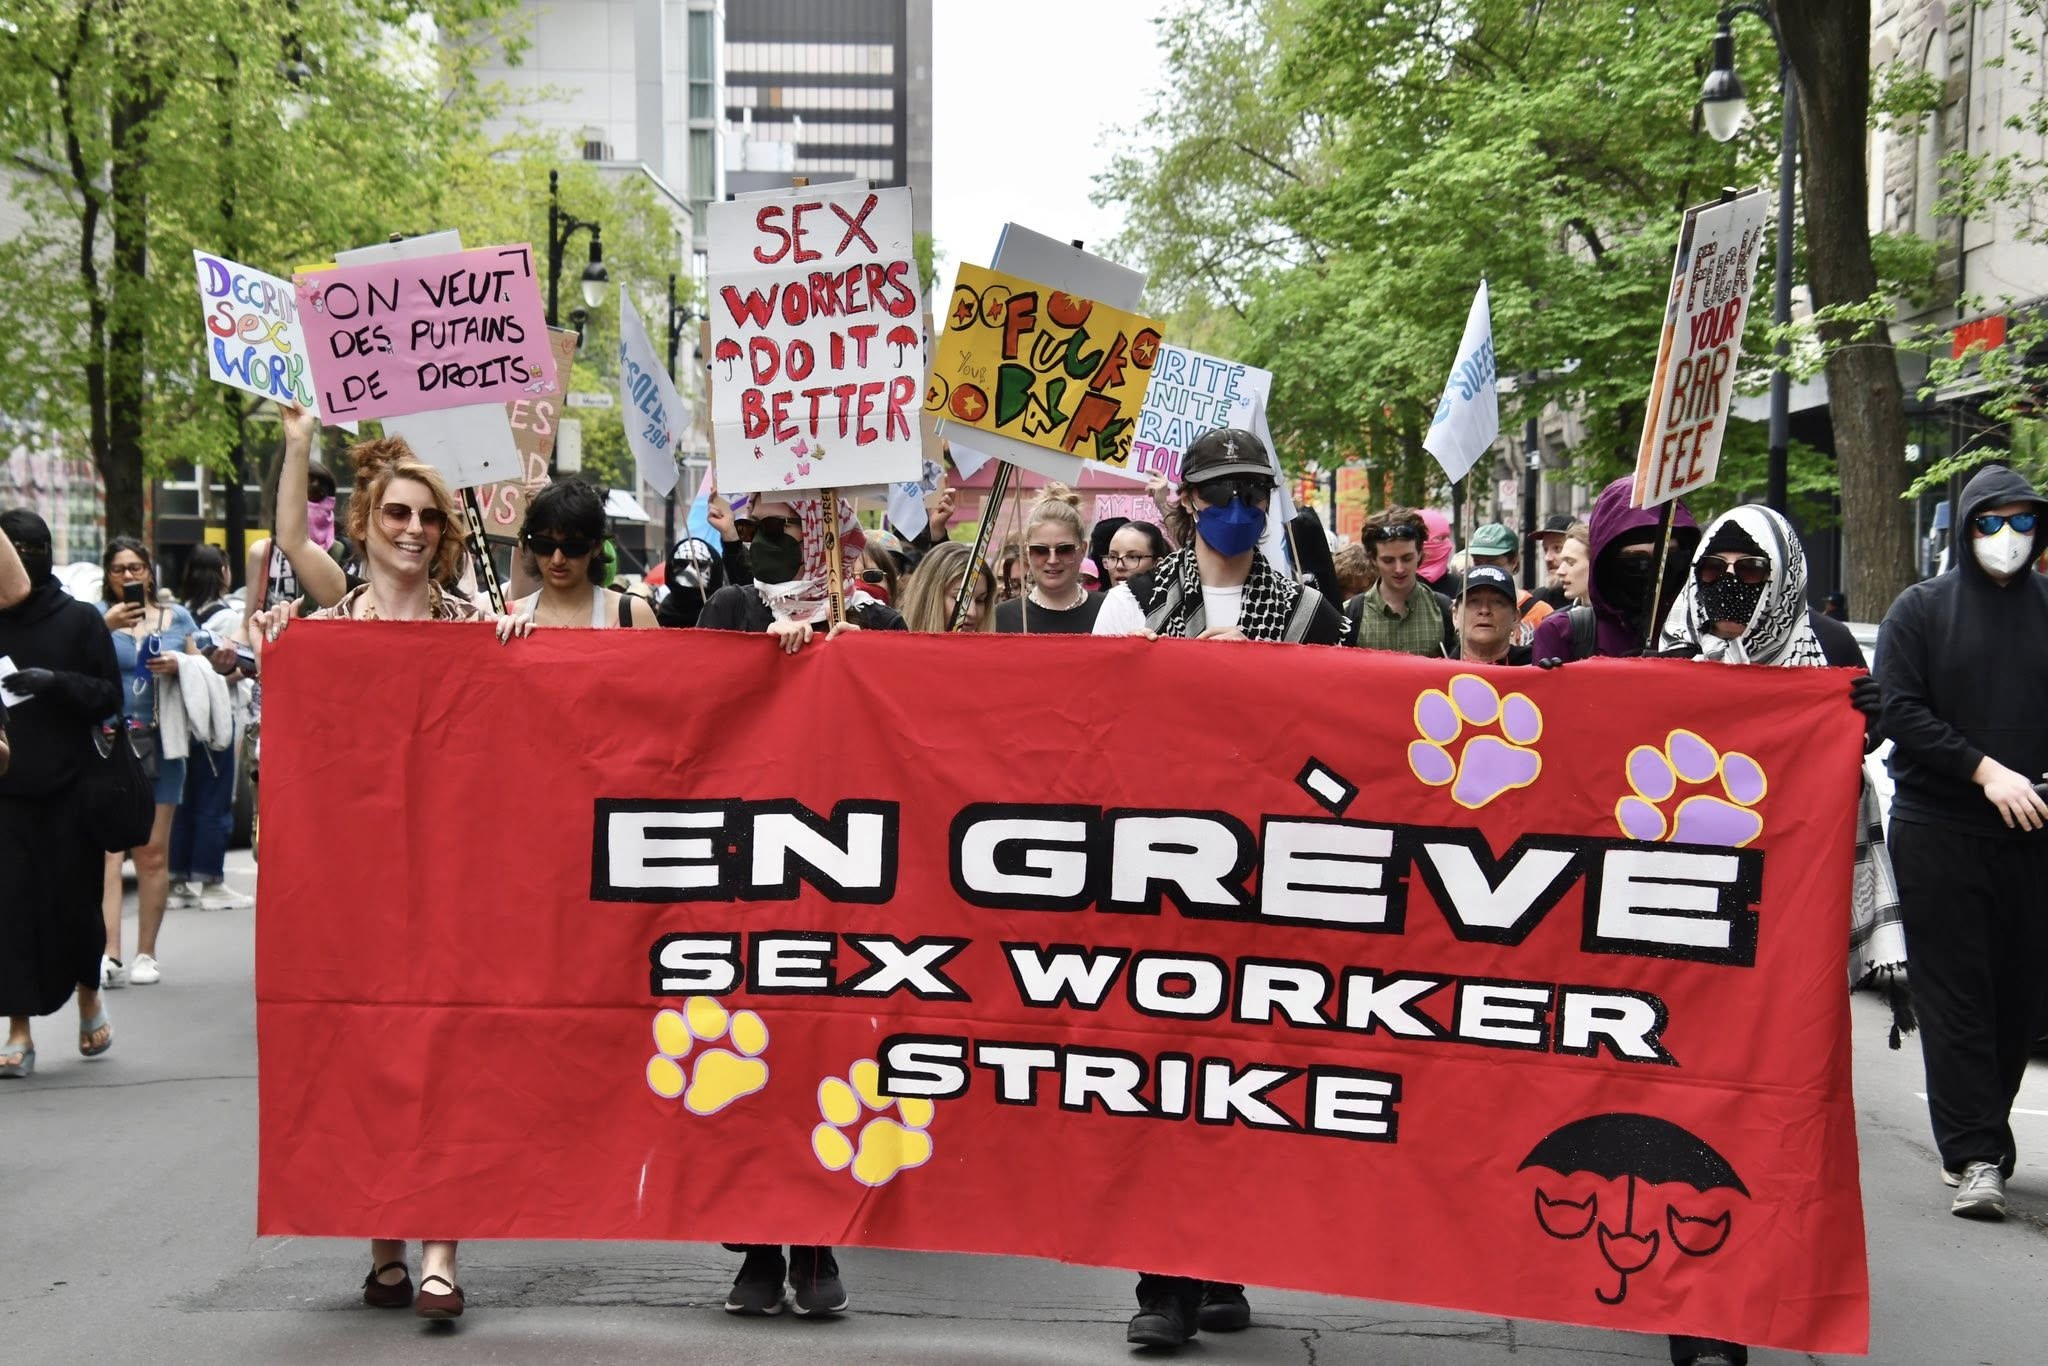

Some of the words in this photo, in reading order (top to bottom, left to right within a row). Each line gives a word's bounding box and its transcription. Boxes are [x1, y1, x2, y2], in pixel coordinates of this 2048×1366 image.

[754, 194, 879, 264] SEX
[324, 278, 399, 320] ON
[418, 269, 515, 308] VEUT
[720, 261, 916, 329] WORKERS
[1687, 296, 1741, 357] YOUR
[330, 325, 392, 358] DES
[411, 315, 525, 350] PUTAINS
[749, 336, 815, 386] DO
[830, 324, 879, 369] IT
[1002, 290, 1127, 392] FUCK
[213, 337, 313, 408] WORK
[342, 370, 388, 403] DE
[416, 354, 531, 392] DROITS
[995, 363, 1070, 438] BAR
[1143, 381, 1232, 428] NITÉ
[1665, 343, 1730, 431] BAR
[642, 422, 668, 450] 298
[741, 375, 916, 446] BETTER
[1654, 420, 1715, 500] FEE
[590, 798, 900, 904] EN
[950, 756, 1764, 967] GRÈVE
[651, 931, 972, 1002] SEX
[1000, 942, 1680, 1067] WORKER
[877, 1033, 1402, 1143] STRIKE
